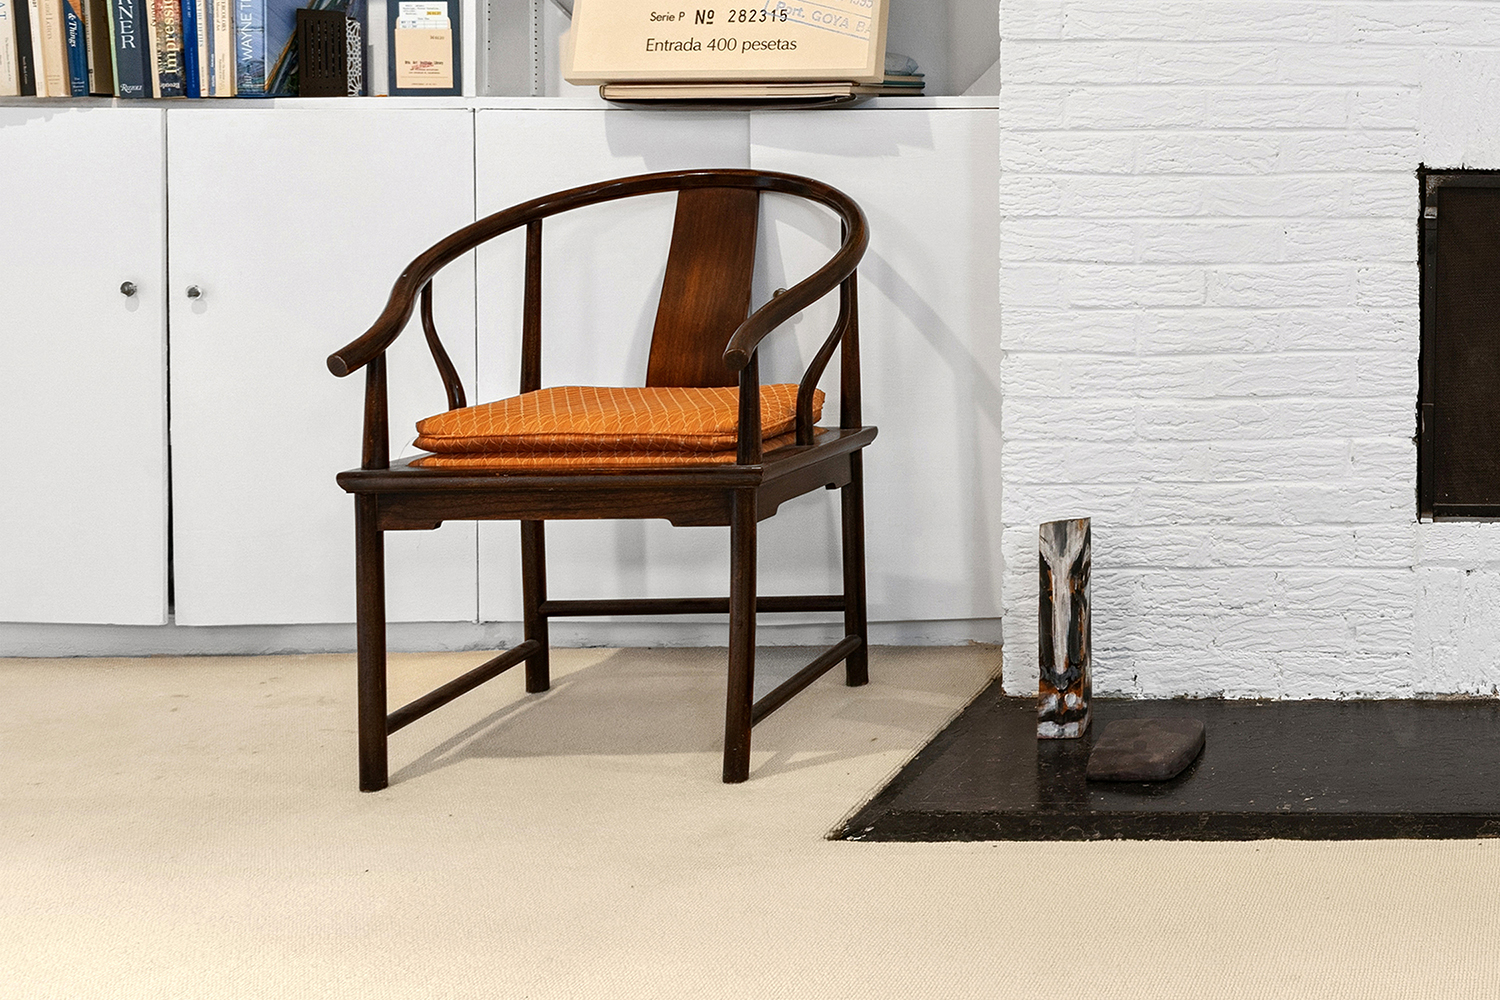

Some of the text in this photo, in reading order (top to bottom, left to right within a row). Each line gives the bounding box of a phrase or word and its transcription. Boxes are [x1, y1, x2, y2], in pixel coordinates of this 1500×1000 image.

[68, 12, 76, 21] &
[650, 10, 675, 22] Serie
[678, 11, 685, 22] P
[728, 9, 788, 23] 282315
[775, 1, 806, 19] Port.
[811, 10, 850, 30] GOYA
[68, 21, 77, 48] Things
[239, 16, 253, 61] WAYNE
[646, 37, 797, 53] Entrada 400 pesetas
